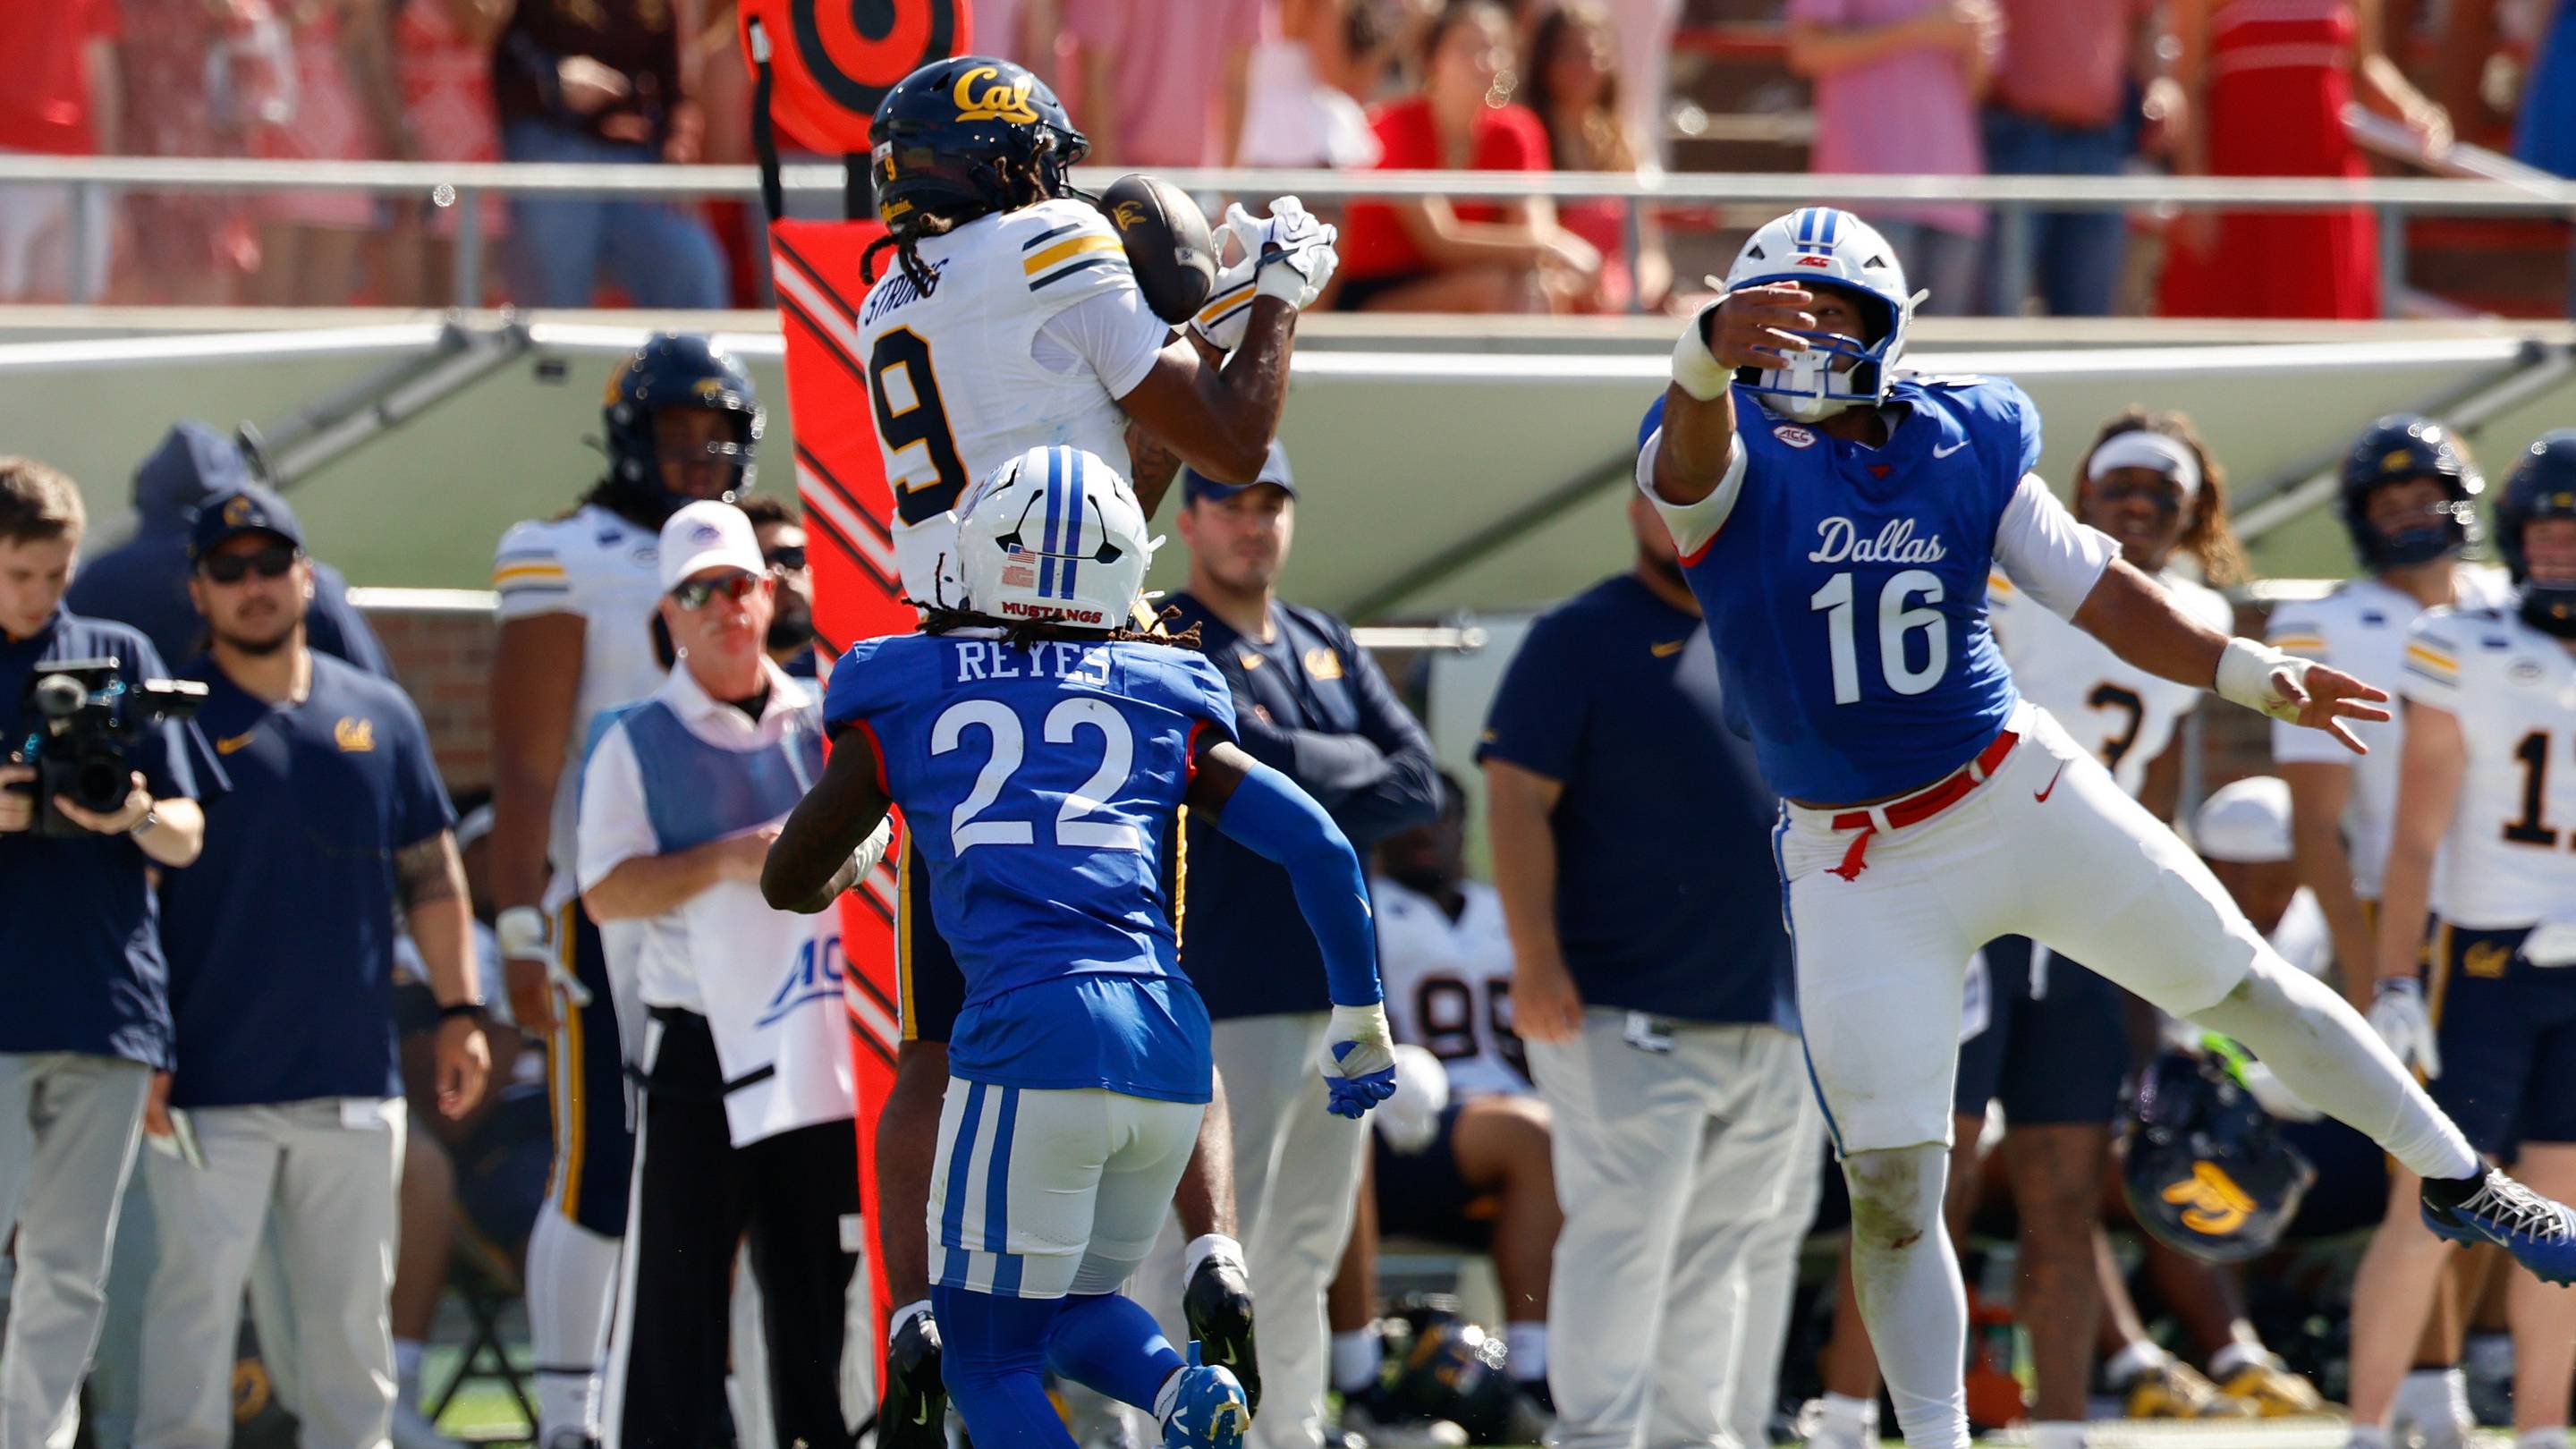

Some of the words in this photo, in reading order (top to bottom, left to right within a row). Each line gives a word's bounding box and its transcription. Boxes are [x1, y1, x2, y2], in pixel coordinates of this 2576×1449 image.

[953, 67, 1039, 124] Cal
[869, 323, 970, 528] 9
[1777, 429, 1809, 444] ACC
[1808, 516, 1947, 564] Dallas
[1002, 601, 1104, 624] MUSTANGS
[1810, 569, 1949, 706] 16
[955, 640, 1111, 687] REYES
[931, 697, 1143, 859] 22
[2501, 729, 2576, 853] 1
